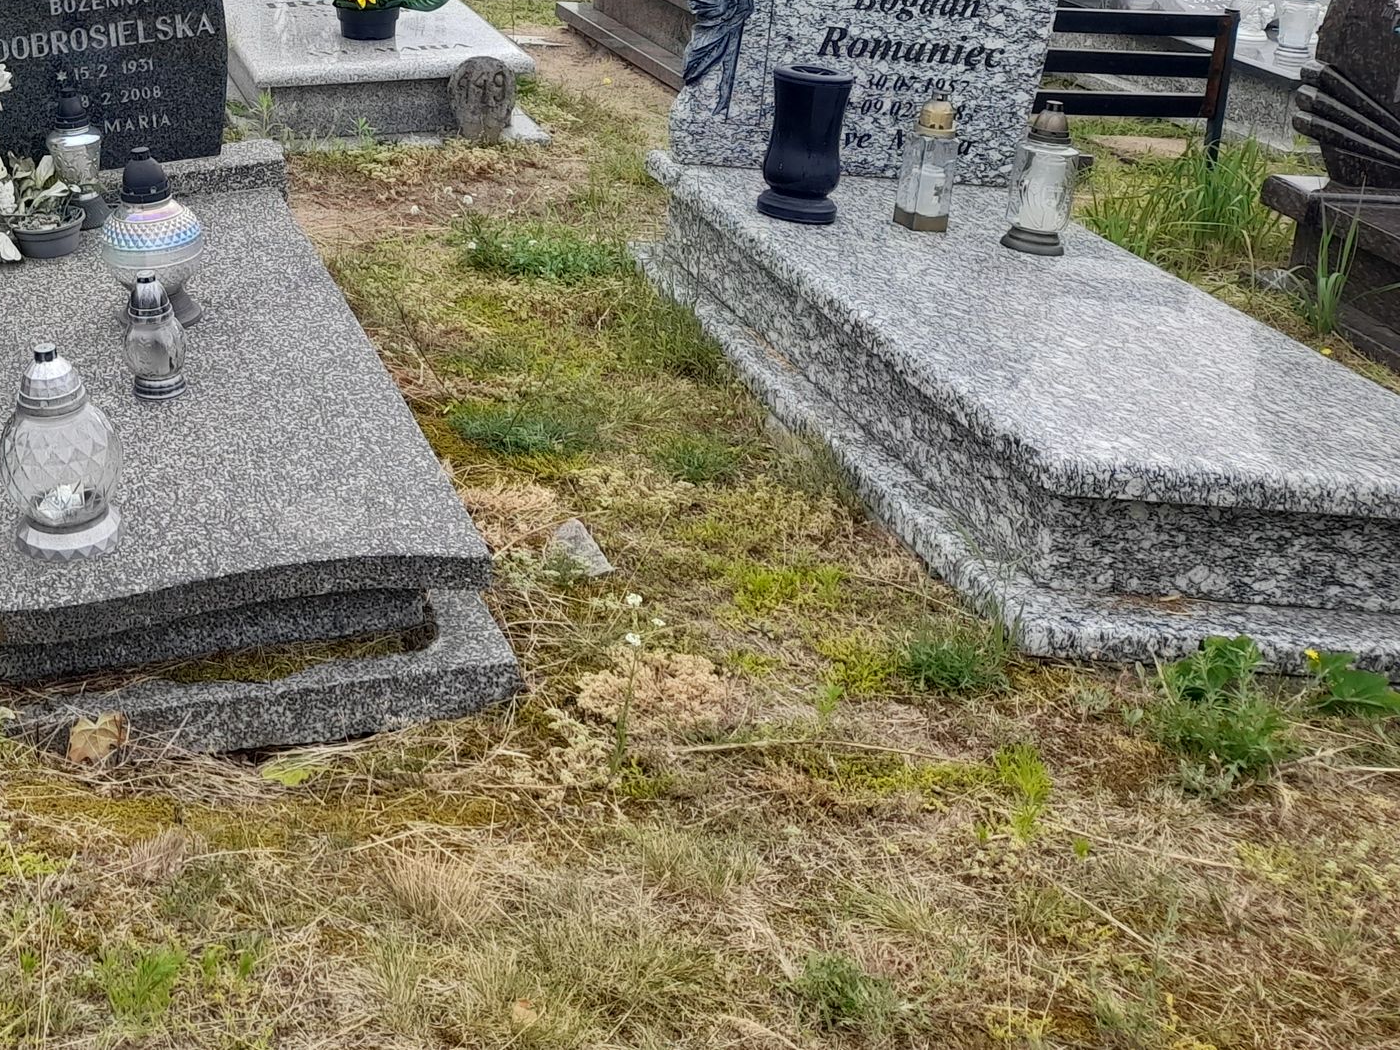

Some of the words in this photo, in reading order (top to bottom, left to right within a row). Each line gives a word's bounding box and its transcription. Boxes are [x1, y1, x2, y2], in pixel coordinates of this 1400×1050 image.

[816, 26, 1006, 69] Romaniec
[121, 57, 154, 75] 1931
[120, 85, 162, 104] 2008
[103, 113, 172, 135] MARIA
